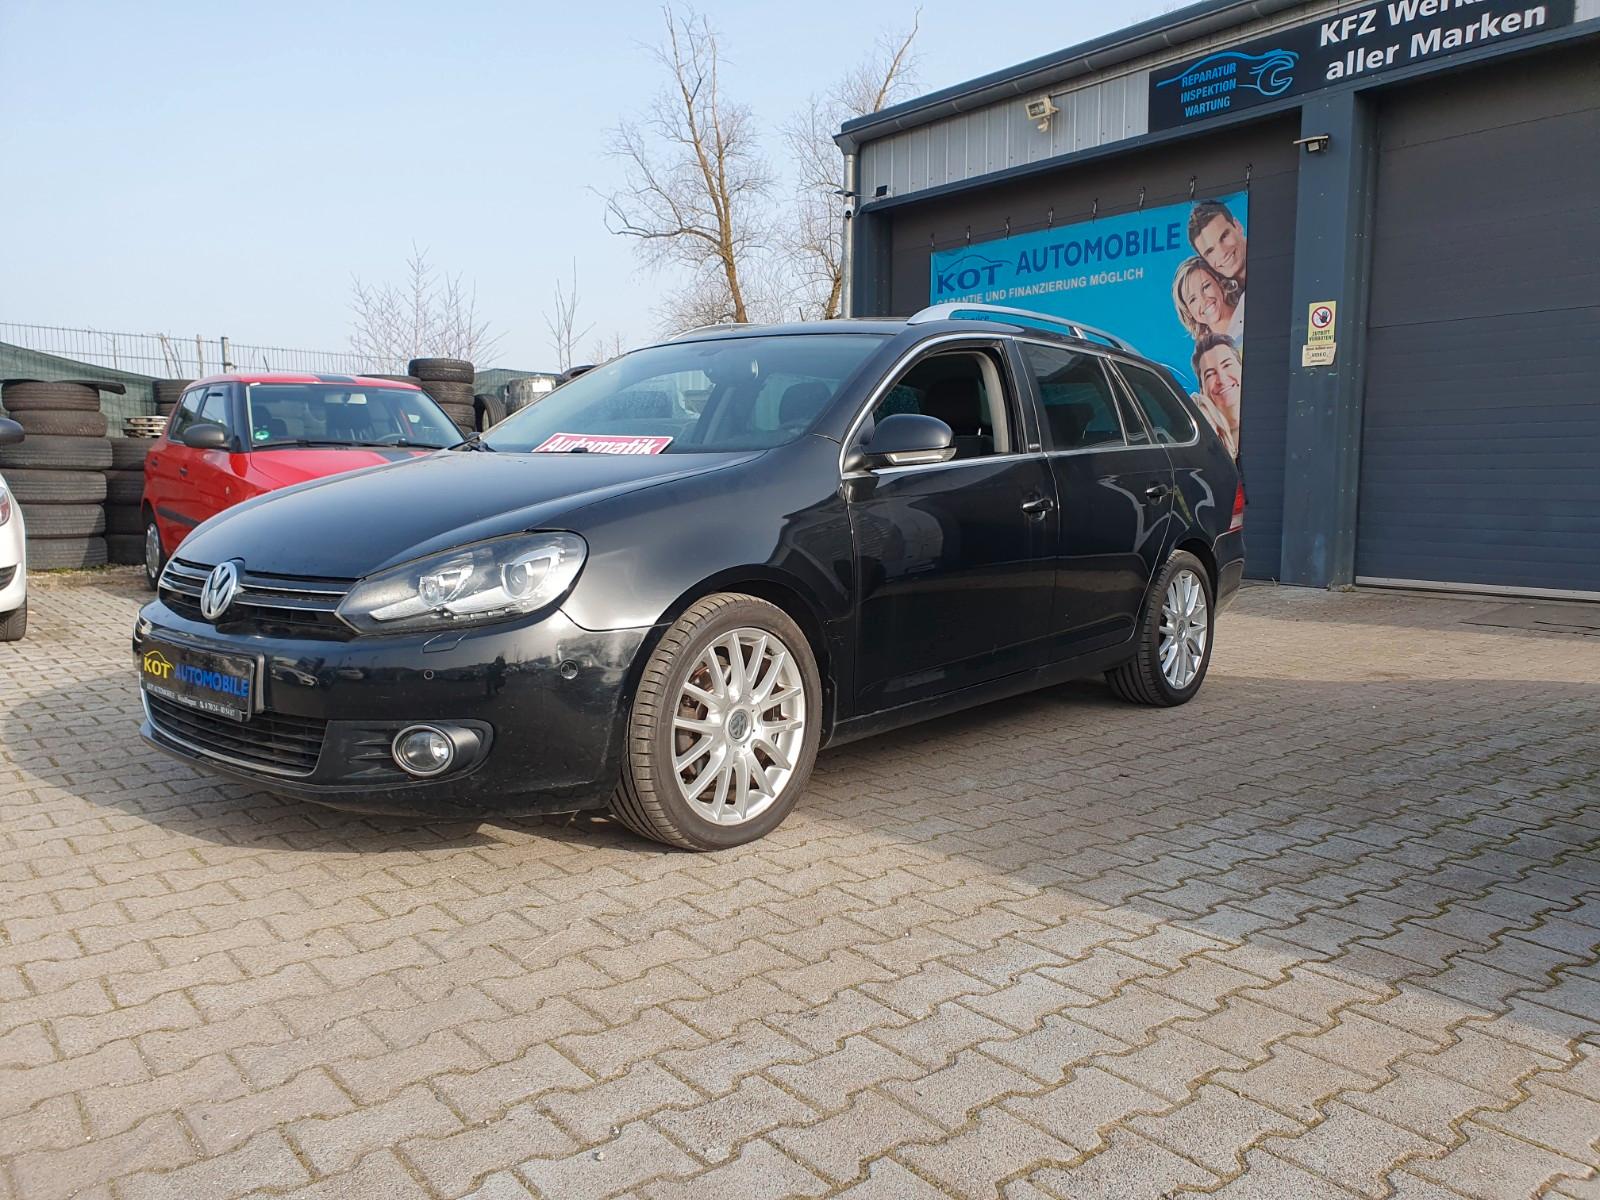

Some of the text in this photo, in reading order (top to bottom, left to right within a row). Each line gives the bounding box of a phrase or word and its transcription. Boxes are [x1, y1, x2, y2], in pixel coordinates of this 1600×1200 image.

[1320, 0, 1485, 47] KFZ Wer
[1326, 5, 1547, 81] aller Marken
[1181, 78, 1237, 104] INSPEKTION
[1182, 62, 1237, 88] REPARATUR
[1185, 96, 1231, 118] WARTUNG
[937, 222, 1181, 294] KOT AUTOMOBILE
[985, 290, 1007, 303] UND
[1008, 276, 1087, 300] FINANZIERUNG
[1089, 267, 1144, 287] MÖGLICH
[542, 436, 657, 454] Automatik
[143, 657, 249, 697] KOT AUTOMOBILE
